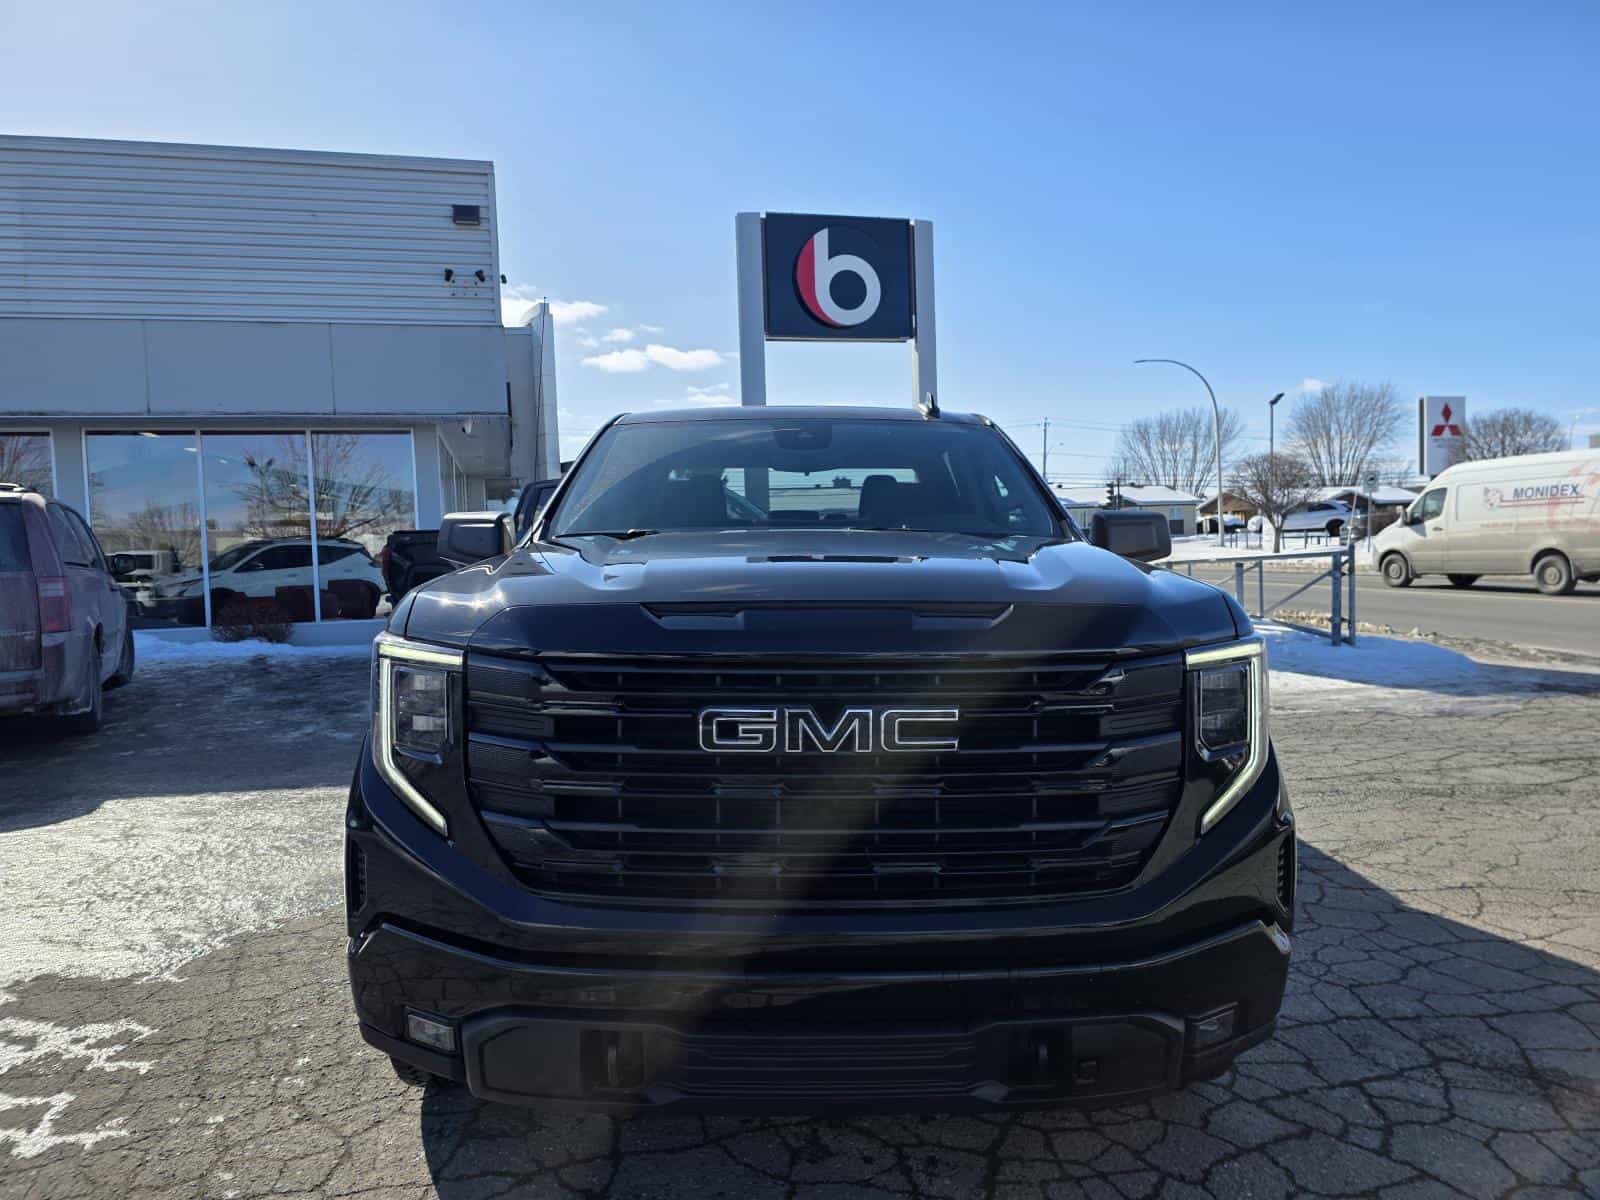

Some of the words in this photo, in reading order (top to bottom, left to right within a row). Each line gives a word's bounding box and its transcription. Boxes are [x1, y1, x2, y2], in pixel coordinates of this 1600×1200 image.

[812, 228, 881, 326] b
[1512, 483, 1580, 500] MONIDEX
[700, 709, 959, 753] GMC
